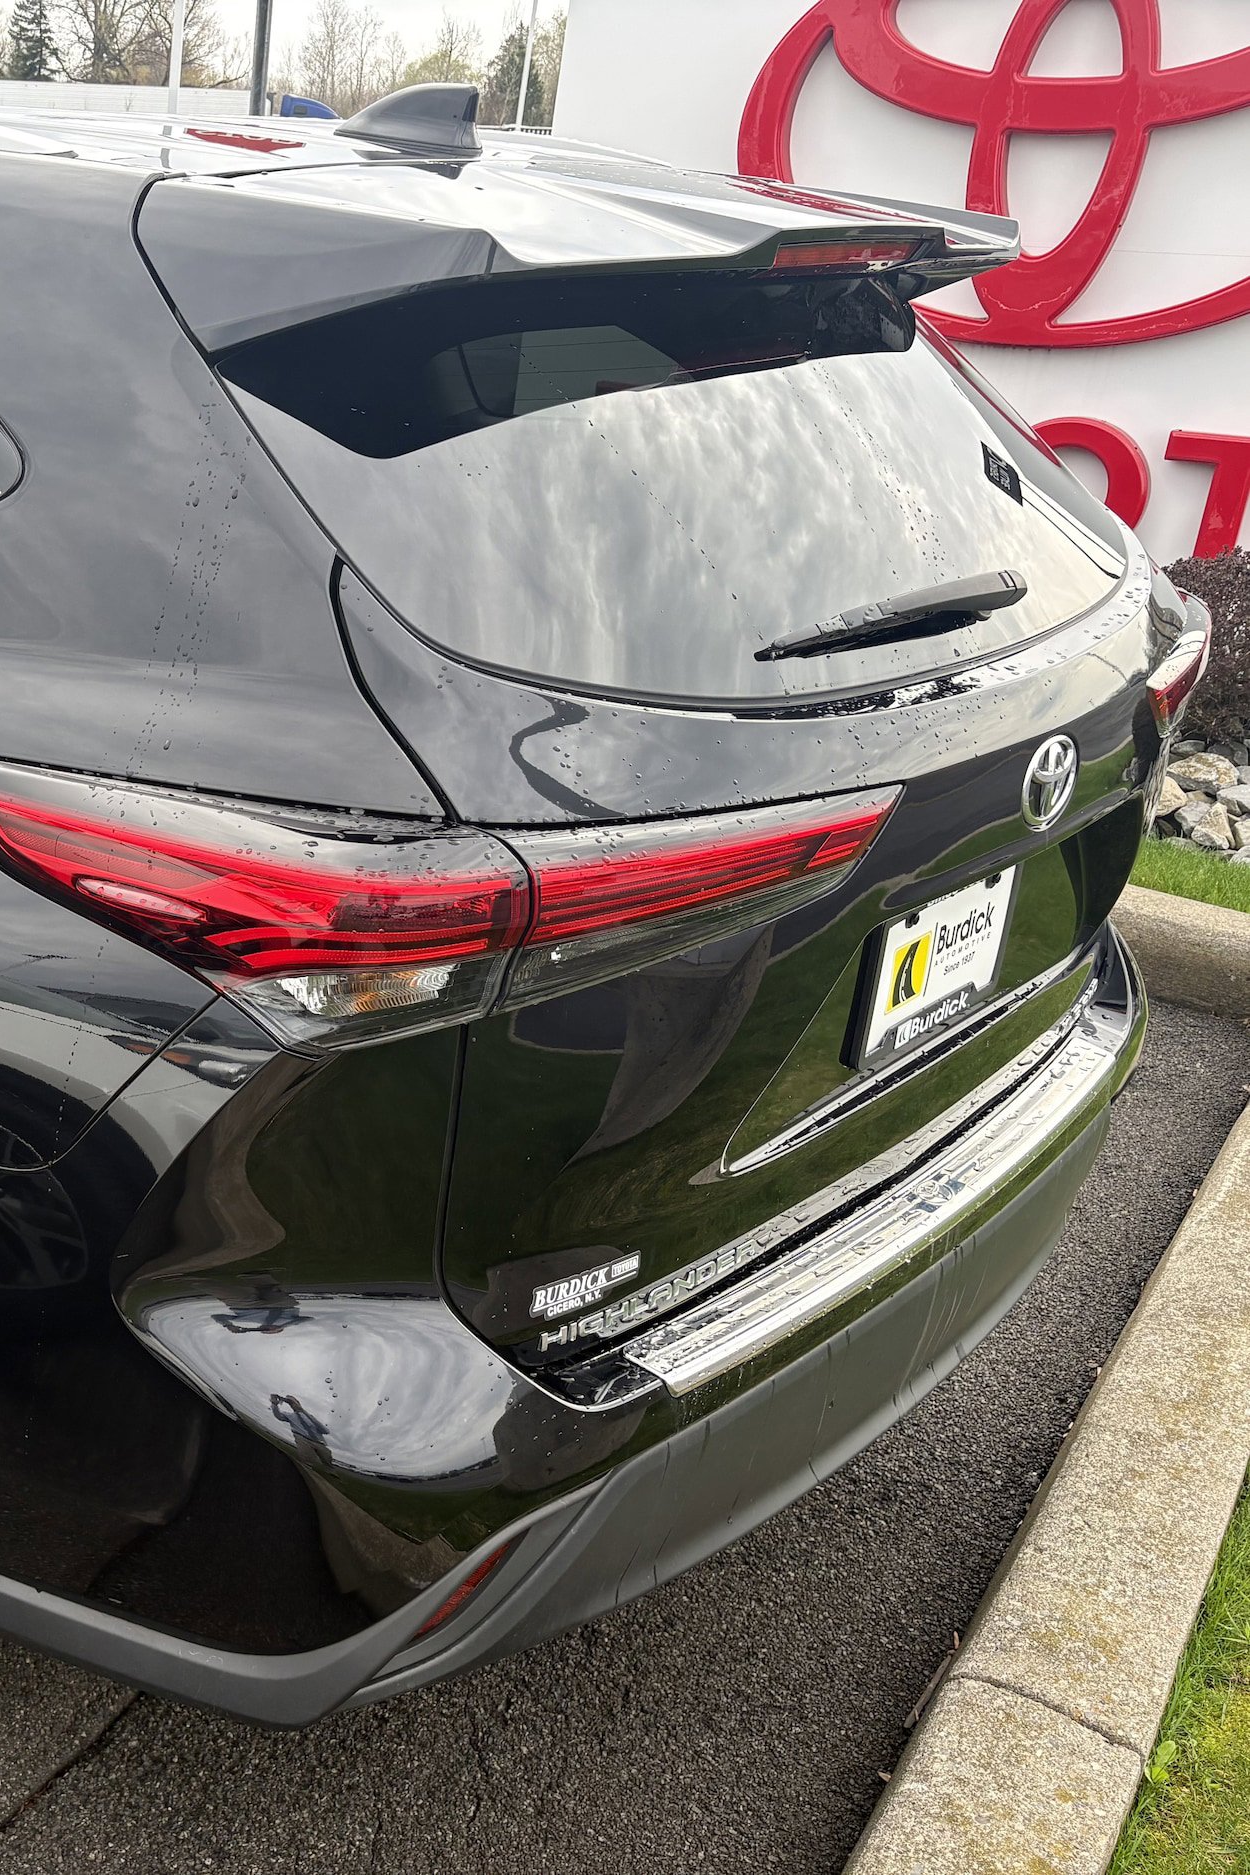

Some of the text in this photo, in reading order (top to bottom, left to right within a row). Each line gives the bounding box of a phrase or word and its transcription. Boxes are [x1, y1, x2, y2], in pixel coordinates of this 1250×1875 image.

[934, 931, 991, 967] AUTOMOTIVE
[936, 901, 995, 955] Burdick
[943, 961, 960, 976] Since
[910, 990, 969, 1040] Burdick
[533, 1256, 639, 1309] BURDICK TOYOTA
[537, 1238, 757, 1352] HIGHLANDER
[546, 1288, 602, 1317] CICERO, N.Y.
